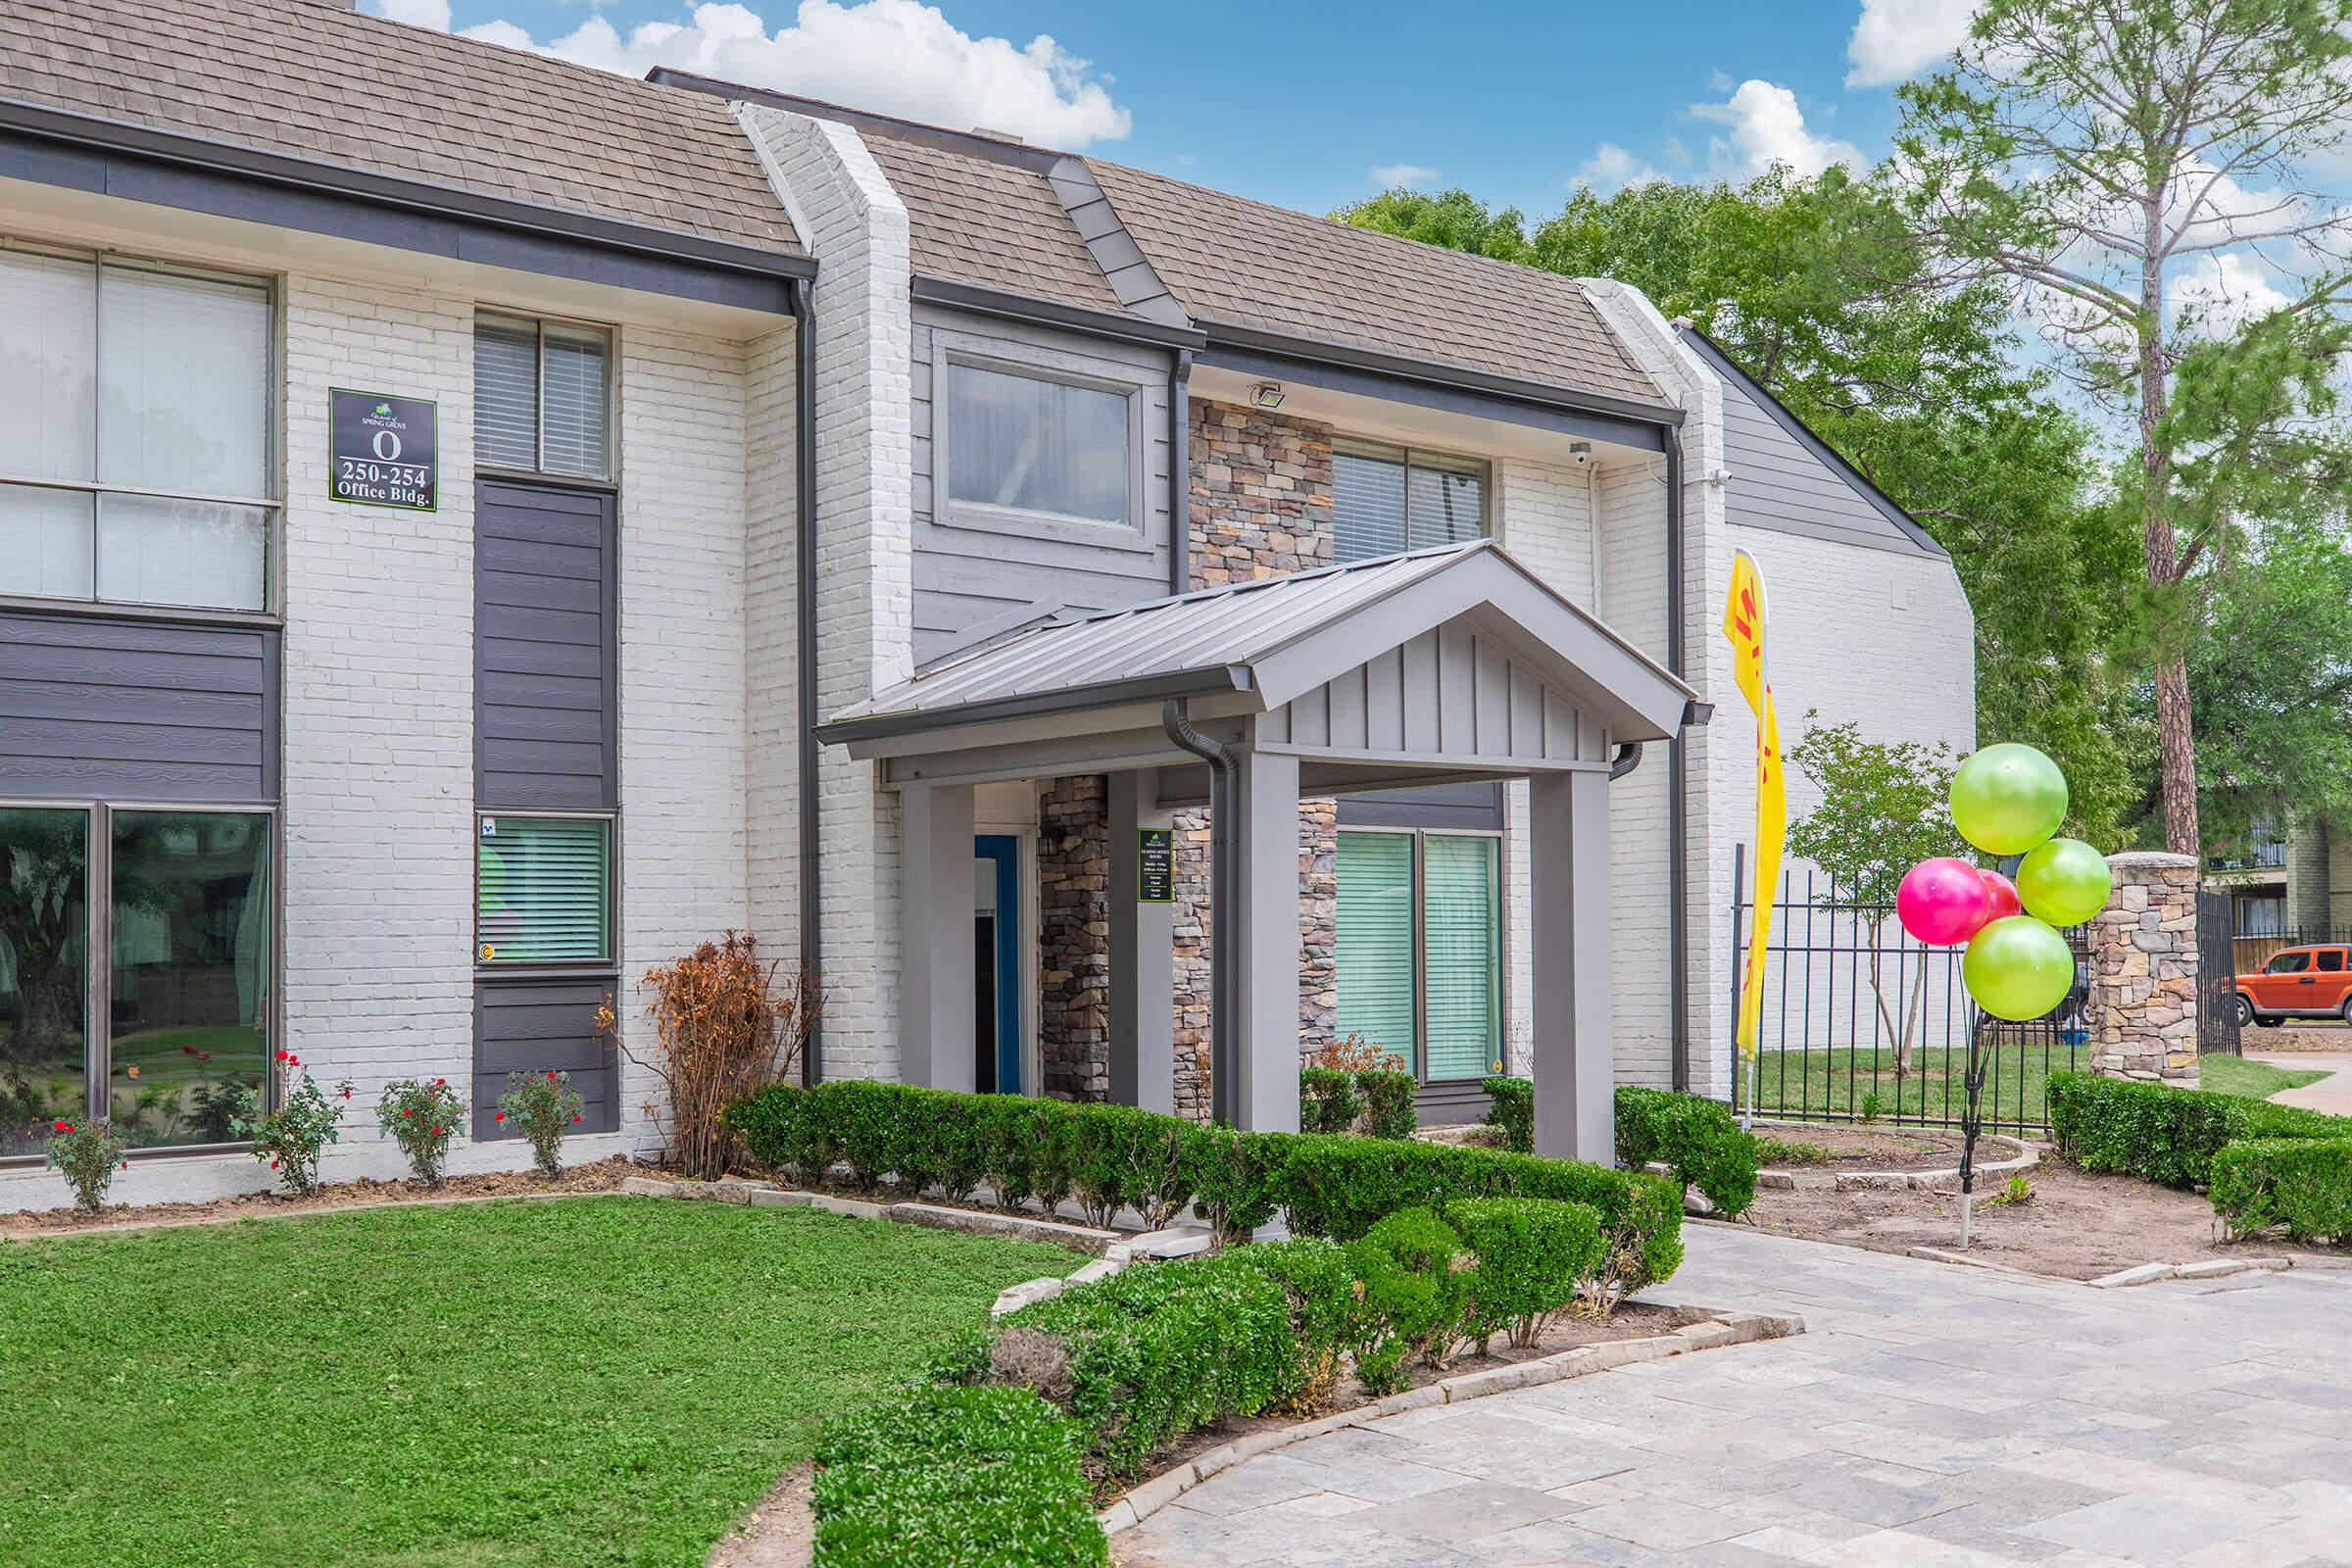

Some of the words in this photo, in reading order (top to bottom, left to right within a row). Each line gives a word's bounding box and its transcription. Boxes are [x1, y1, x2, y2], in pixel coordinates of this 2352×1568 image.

[362, 417, 385, 426] SPRING
[385, 420, 408, 429] GROVE
[372, 430, 402, 461] O
[342, 461, 426, 488] 250-254
[338, 481, 386, 499] Office
[390, 486, 429, 507] Bldg.
